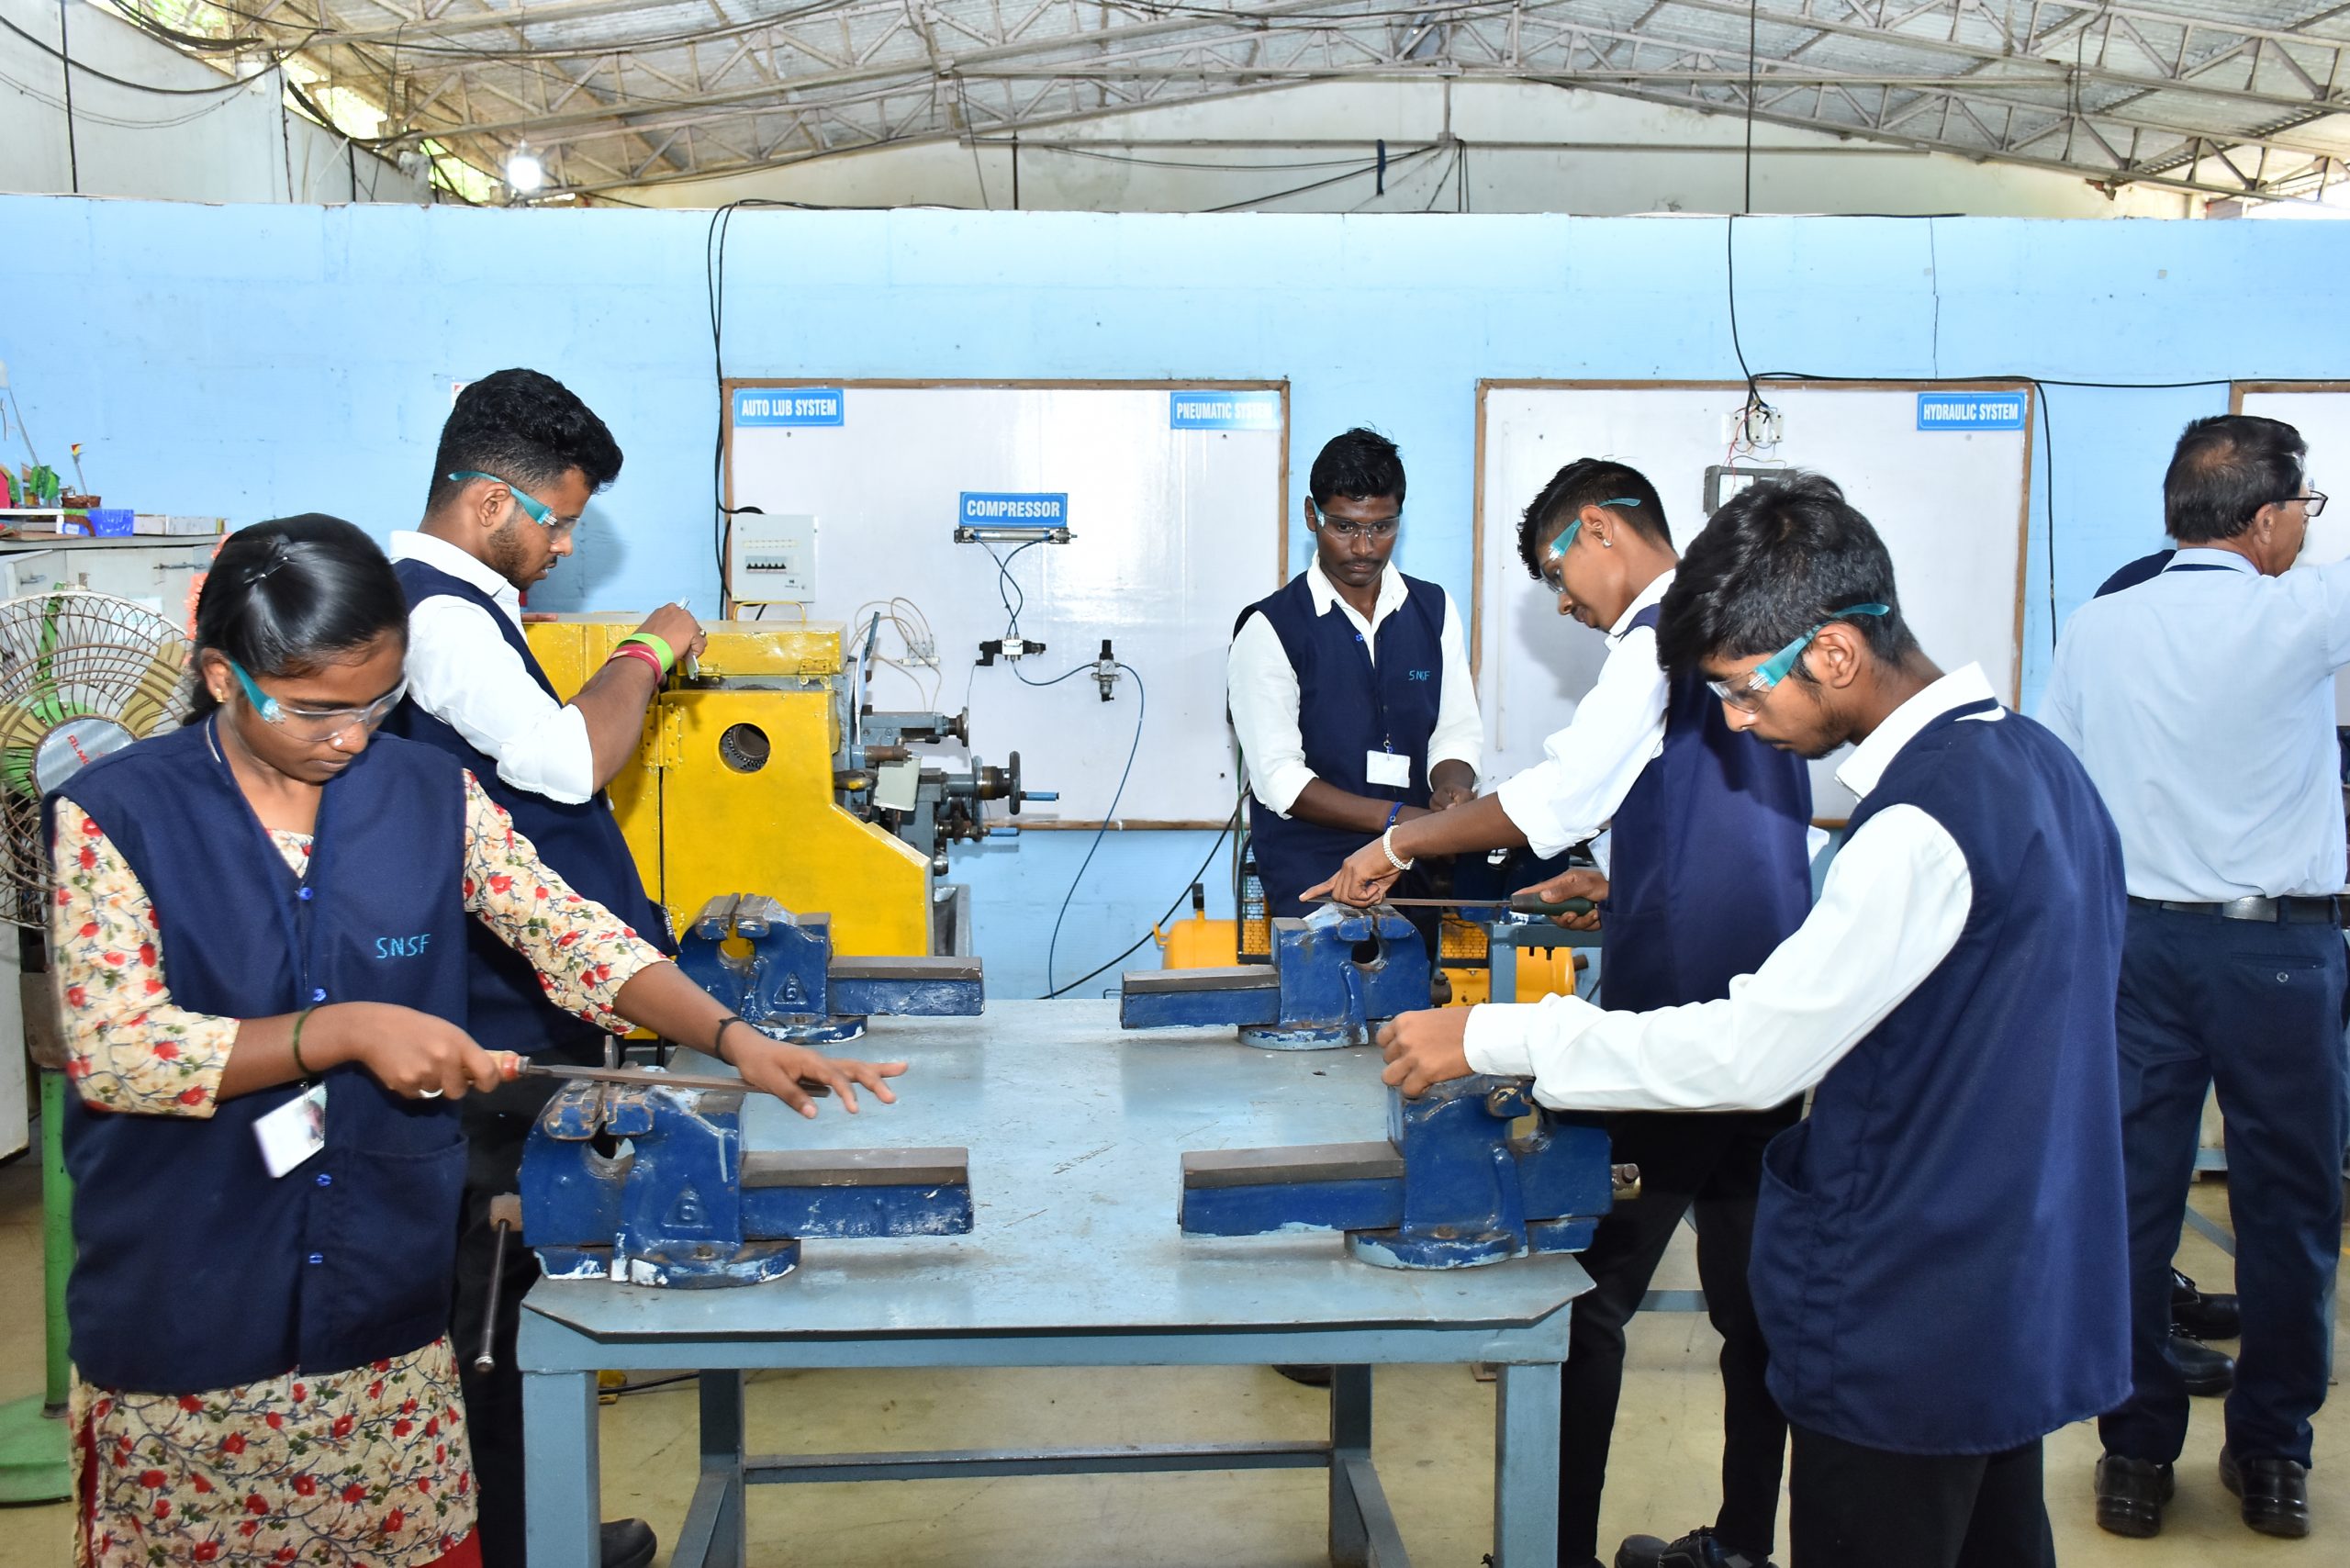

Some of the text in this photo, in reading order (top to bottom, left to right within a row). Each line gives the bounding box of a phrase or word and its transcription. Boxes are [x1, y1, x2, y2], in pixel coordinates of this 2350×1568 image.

[742, 398, 837, 416] AUTO LUB SYSTEM
[1177, 402, 1232, 420] PNEUMATIC
[1923, 403, 2019, 420] HYDRAULIC SYSTEM
[967, 499, 1061, 518] COMPRESSOR
[375, 934, 431, 958] SNSF
